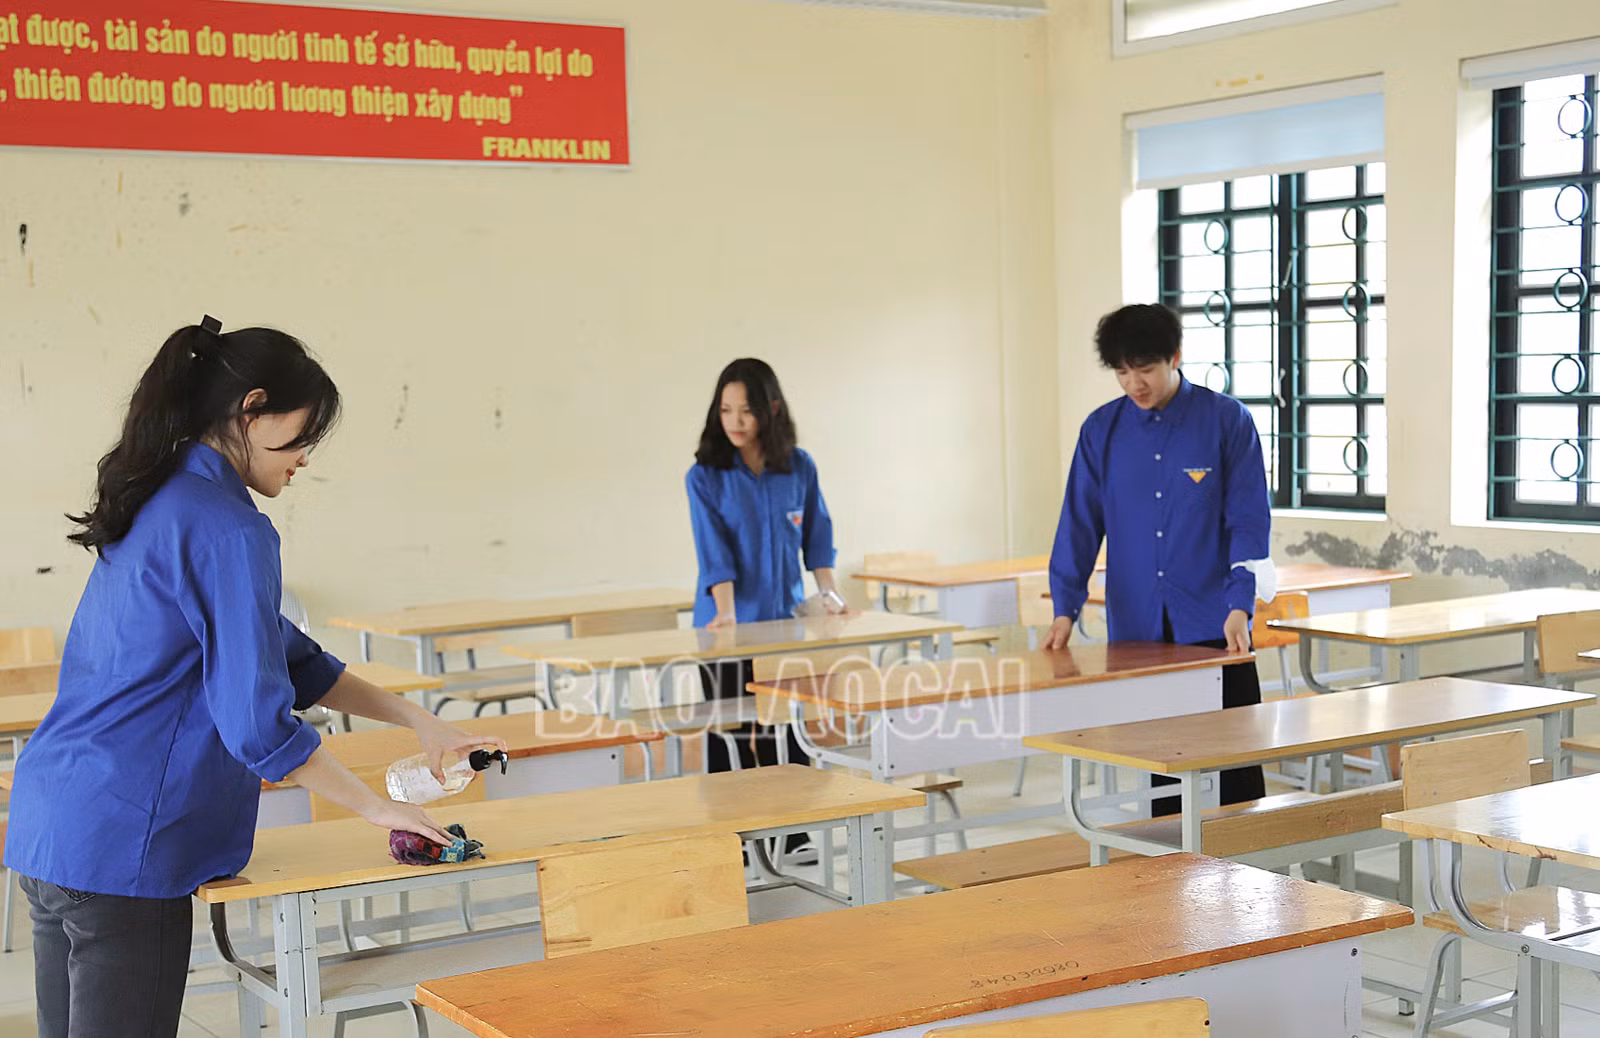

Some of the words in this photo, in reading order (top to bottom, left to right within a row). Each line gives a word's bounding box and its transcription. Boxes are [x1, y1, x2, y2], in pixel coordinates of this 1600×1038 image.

[26, 14, 98, 54] được,
[104, 19, 138, 51] tài
[145, 19, 189, 54] sản
[196, 26, 226, 56] do
[233, 30, 298, 62] người
[304, 32, 349, 63] tinh
[354, 31, 378, 65] tế
[383, 34, 409, 67] sở
[414, 39, 462, 72] hữu,
[535, 46, 562, 81] lợi
[568, 49, 593, 77] do
[14, 68, 81, 101] thiên
[88, 72, 165, 109] đường
[172, 76, 202, 107] do
[209, 80, 275, 112] người
[282, 82, 346, 117] lương
[352, 85, 409, 122] thiện
[414, 88, 453, 121] xây
[482, 136, 611, 160] FRANKLIN
